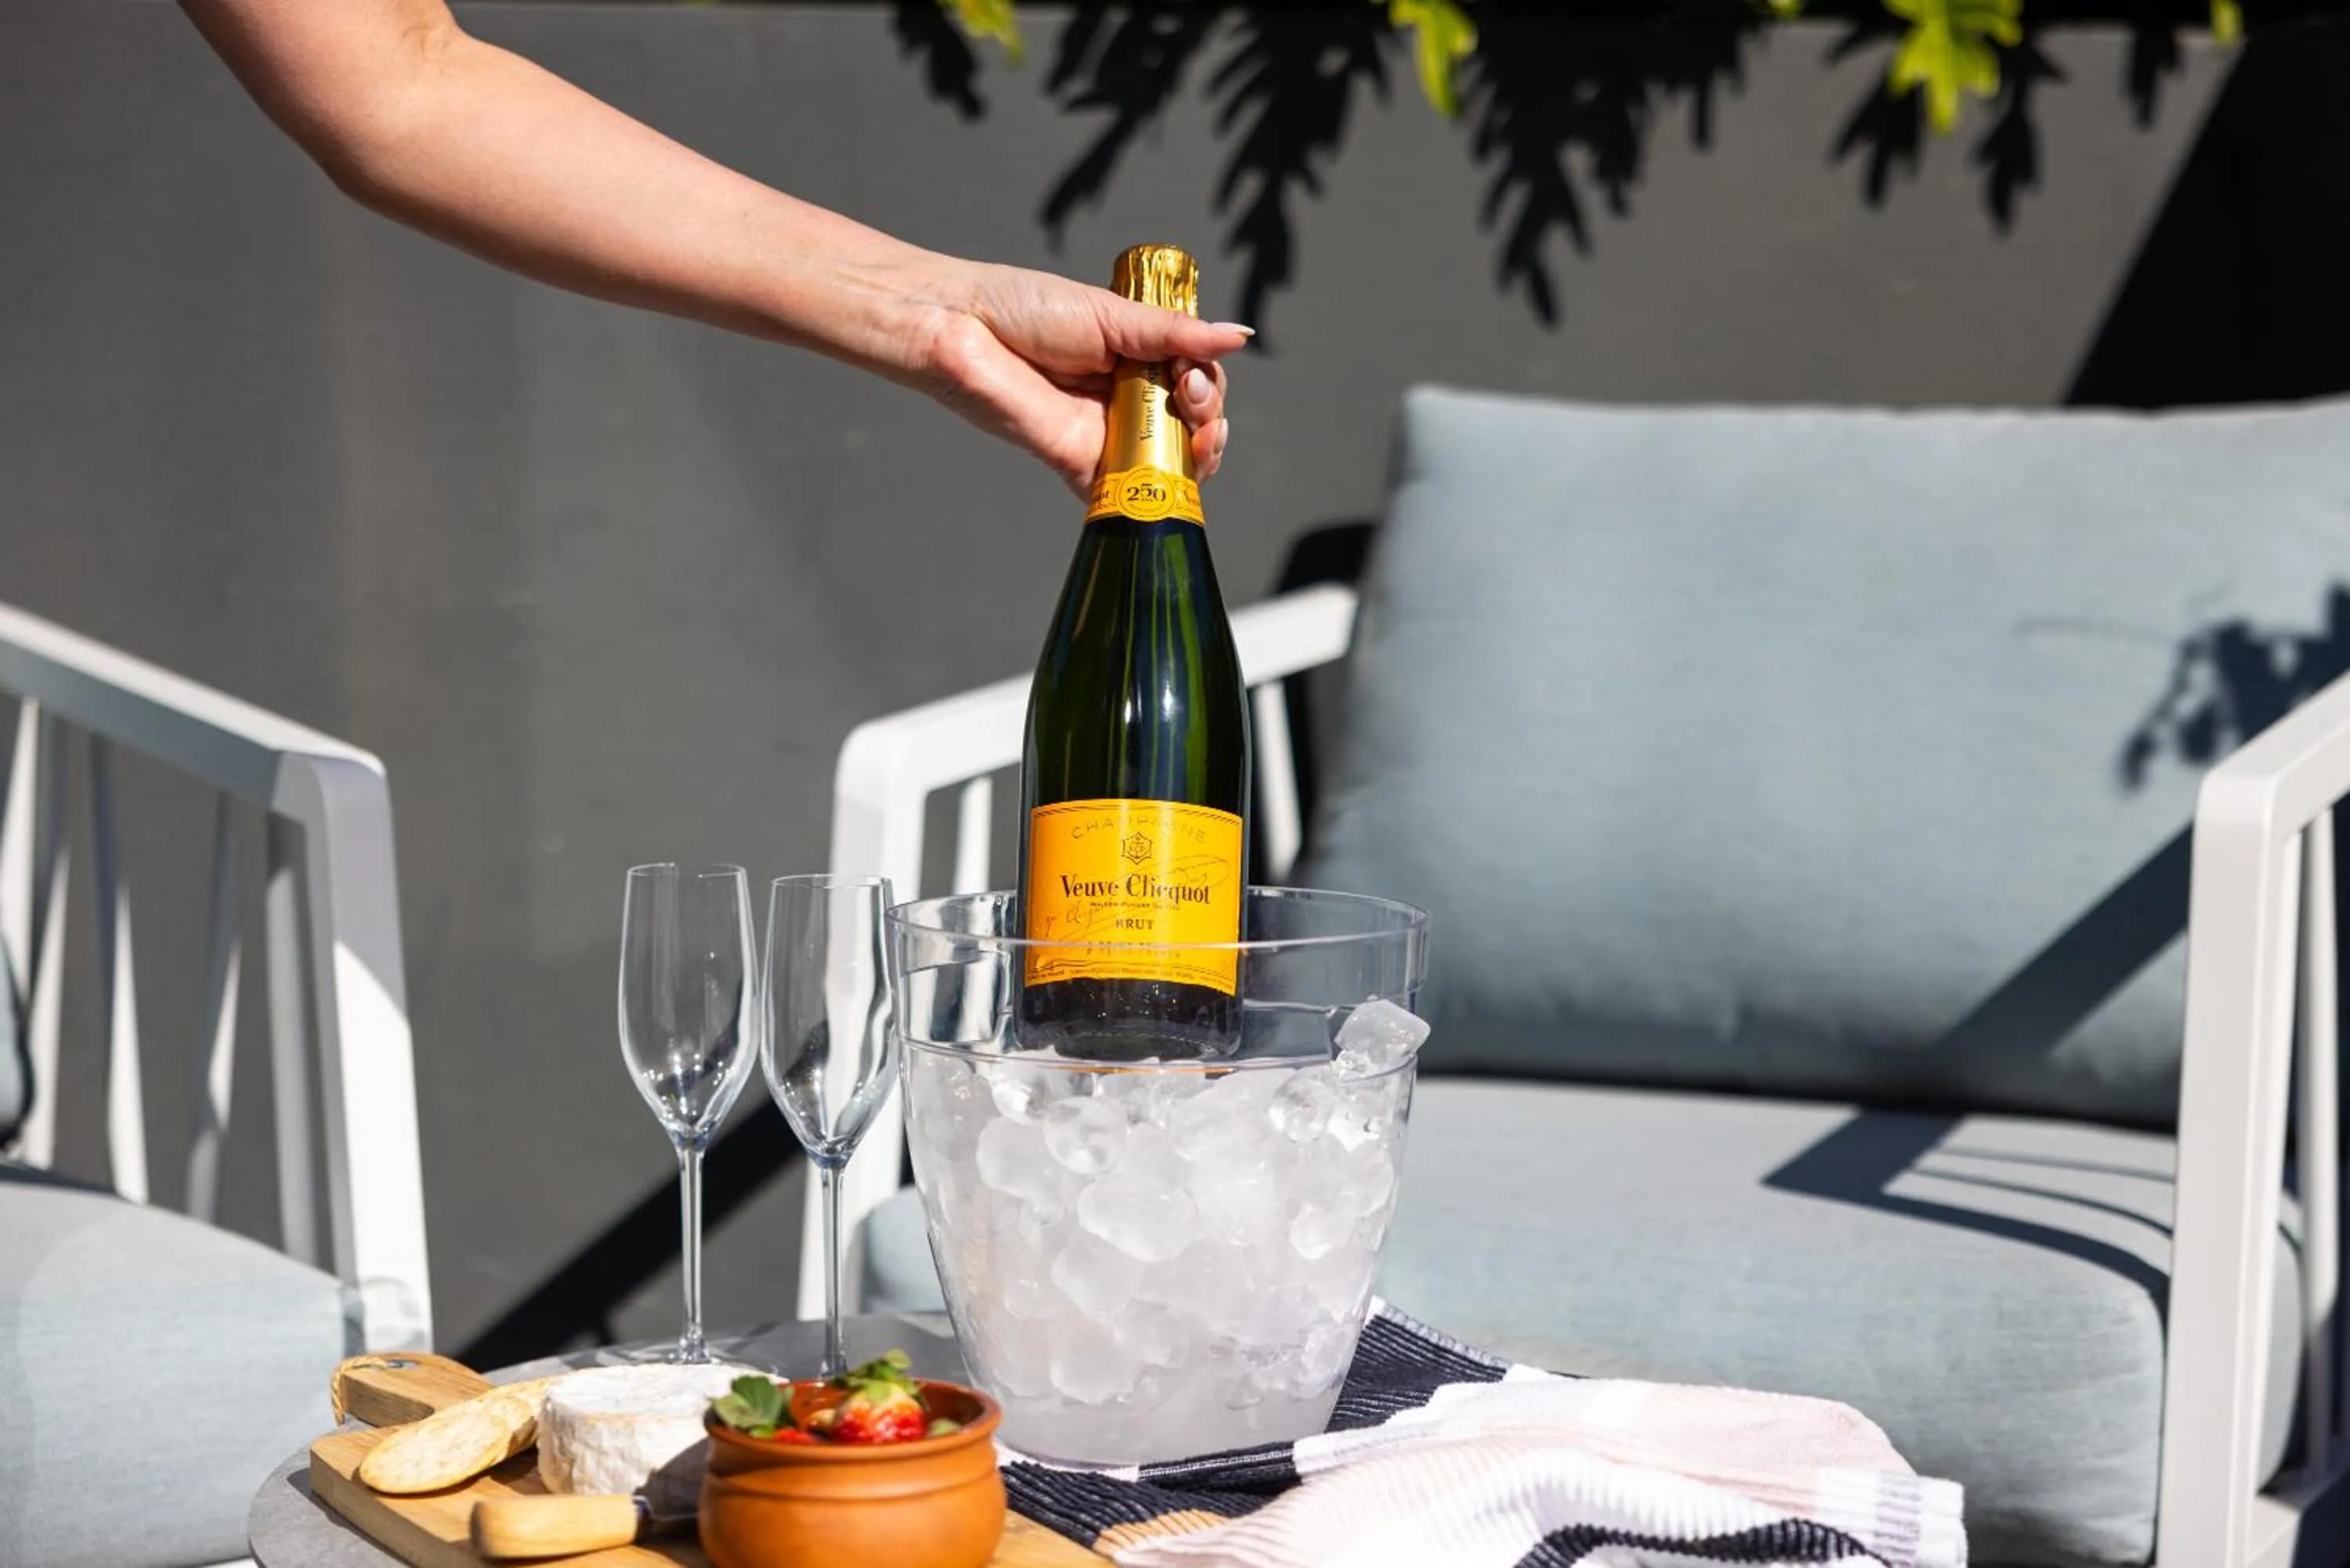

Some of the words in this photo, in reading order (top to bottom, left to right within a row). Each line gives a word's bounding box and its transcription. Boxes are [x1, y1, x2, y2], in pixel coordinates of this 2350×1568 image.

[1140, 406, 1155, 442] Veuve
[1126, 482, 1166, 502] 250
[1070, 814, 1207, 844] CHAPNE
[1061, 874, 1119, 898] Veuve
[1126, 873, 1211, 905] Clicquot
[1115, 918, 1155, 930] BRUT
